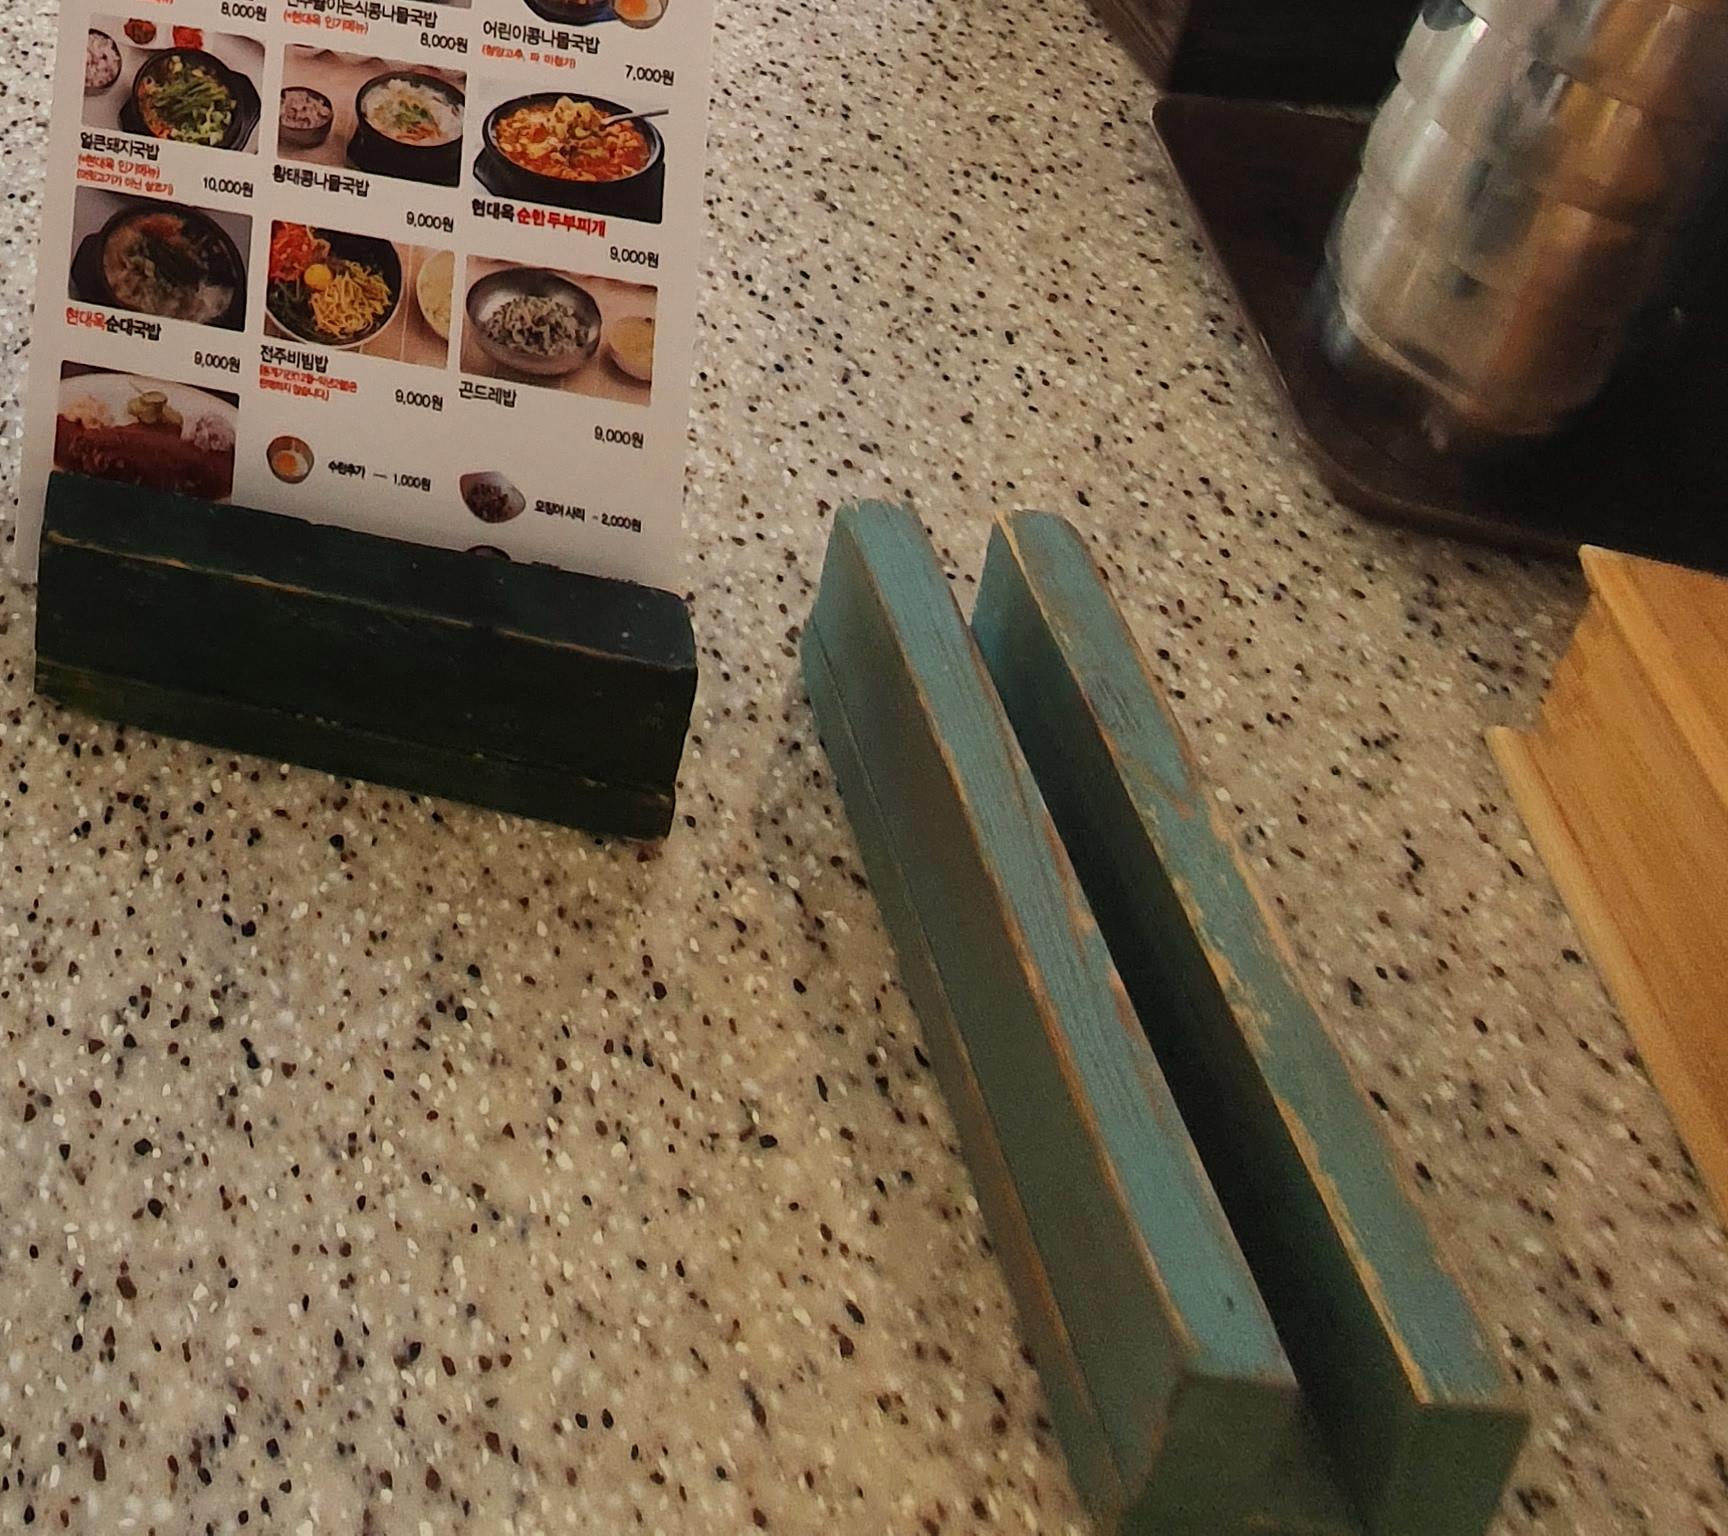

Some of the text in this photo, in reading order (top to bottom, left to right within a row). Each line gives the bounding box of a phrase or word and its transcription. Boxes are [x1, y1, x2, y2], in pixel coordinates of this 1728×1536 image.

[221, 1, 268, 22] 8,000원
[420, 32, 469, 54] 8,000원
[482, 20, 601, 55] 어린이콩나물국밥
[624, 64, 675, 86] 7,000원
[79, 131, 161, 162] 얼큰돼지국밥
[202, 175, 254, 198] 10,000원
[272, 163, 370, 198] 황태콩나물국밥
[406, 210, 454, 233] 9,000원
[471, 197, 515, 223] 현대옥
[609, 245, 660, 269] 9,000원
[65, 306, 162, 341] 현대옥순대국밥
[259, 344, 329, 374] 전주비빔밥
[394, 388, 444, 411] 9,000원
[458, 380, 518, 408] 곤드레밥
[594, 425, 644, 449] 9,000원
